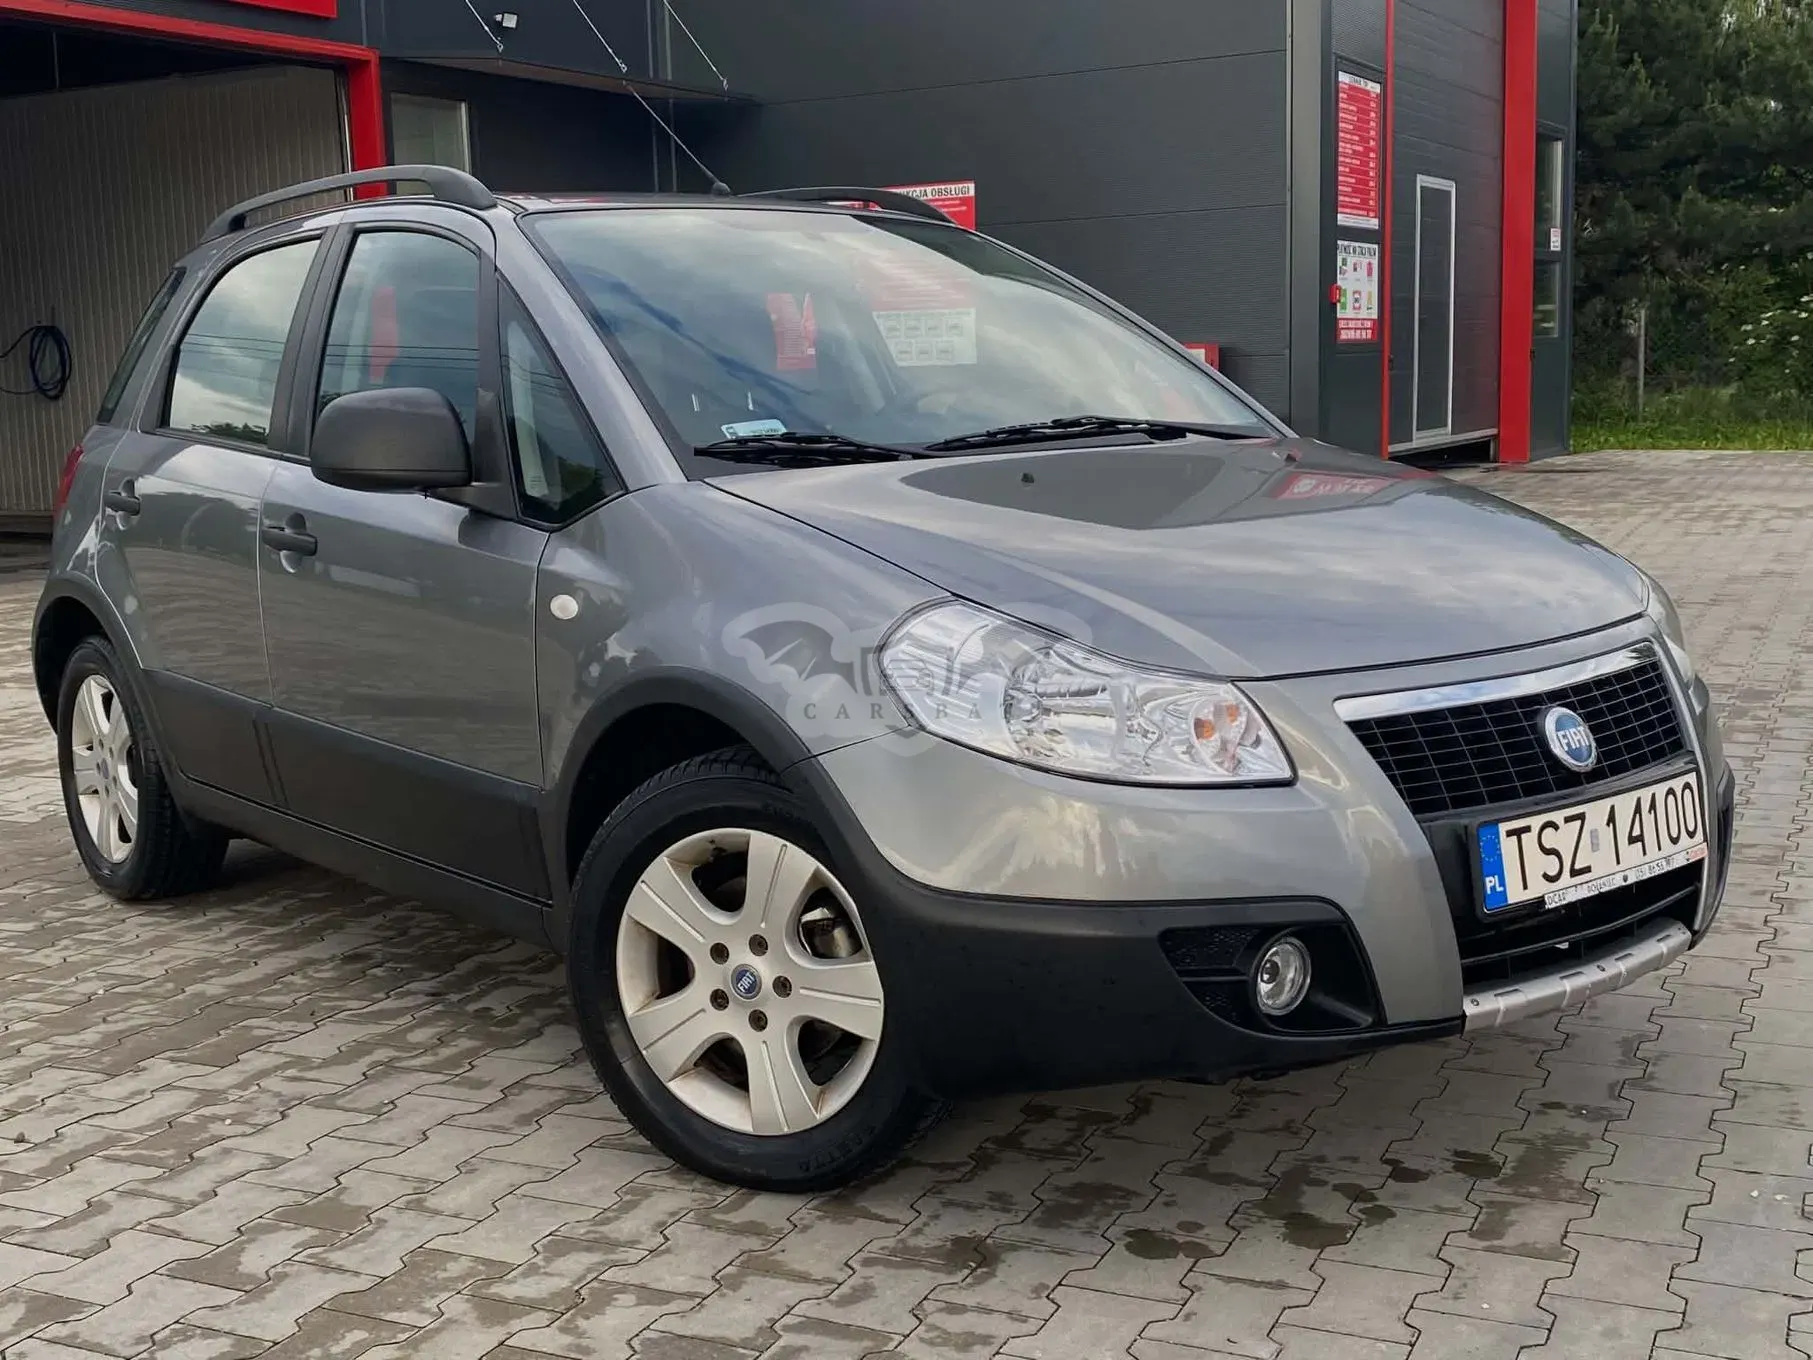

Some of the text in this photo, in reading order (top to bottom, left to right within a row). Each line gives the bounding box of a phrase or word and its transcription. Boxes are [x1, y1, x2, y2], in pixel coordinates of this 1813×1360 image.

[931, 184, 970, 198] OBSŁUGI
[1557, 726, 1590, 752] FIAT
[1506, 781, 1699, 891] TSZ 14100
[1485, 876, 1504, 894] PL
[737, 971, 756, 993] FIAT
